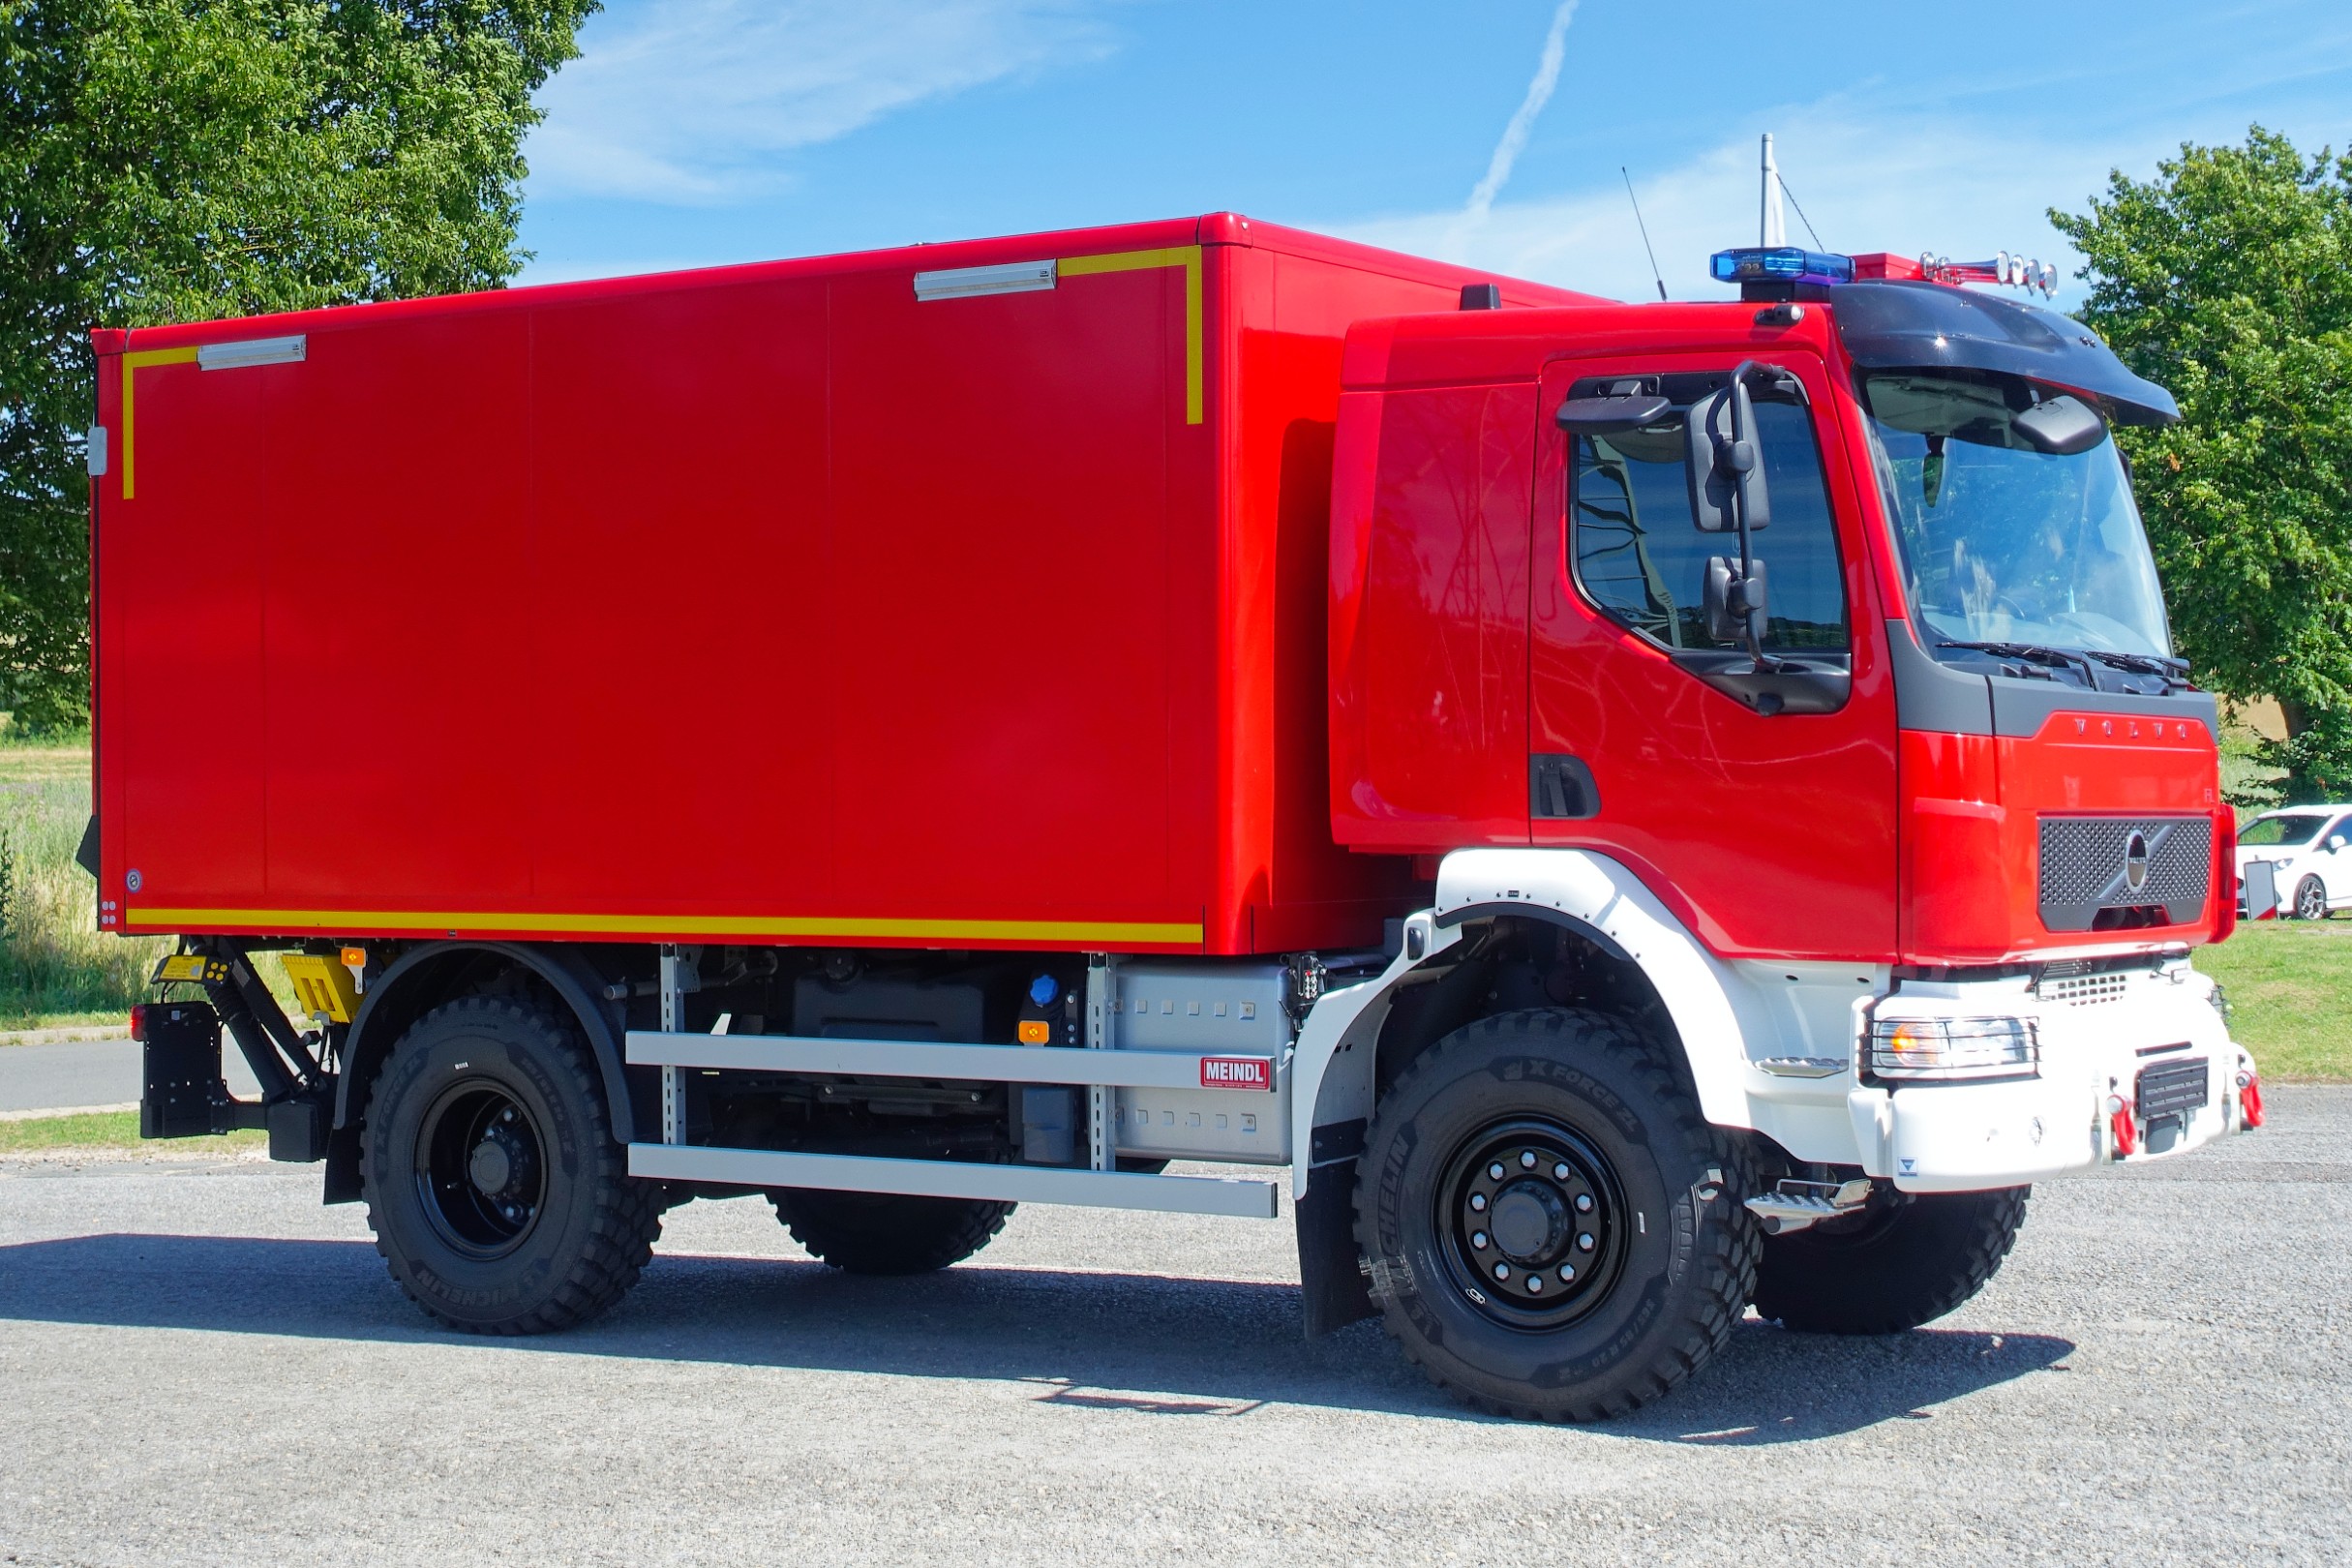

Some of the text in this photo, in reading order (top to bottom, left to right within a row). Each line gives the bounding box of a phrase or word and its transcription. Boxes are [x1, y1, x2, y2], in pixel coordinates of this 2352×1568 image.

[2074, 718, 2187, 739] VOLVO
[1206, 1061, 1264, 1082] MEINDL
[1528, 1059, 1548, 1076] X
[1552, 1064, 1620, 1109] FORCE
